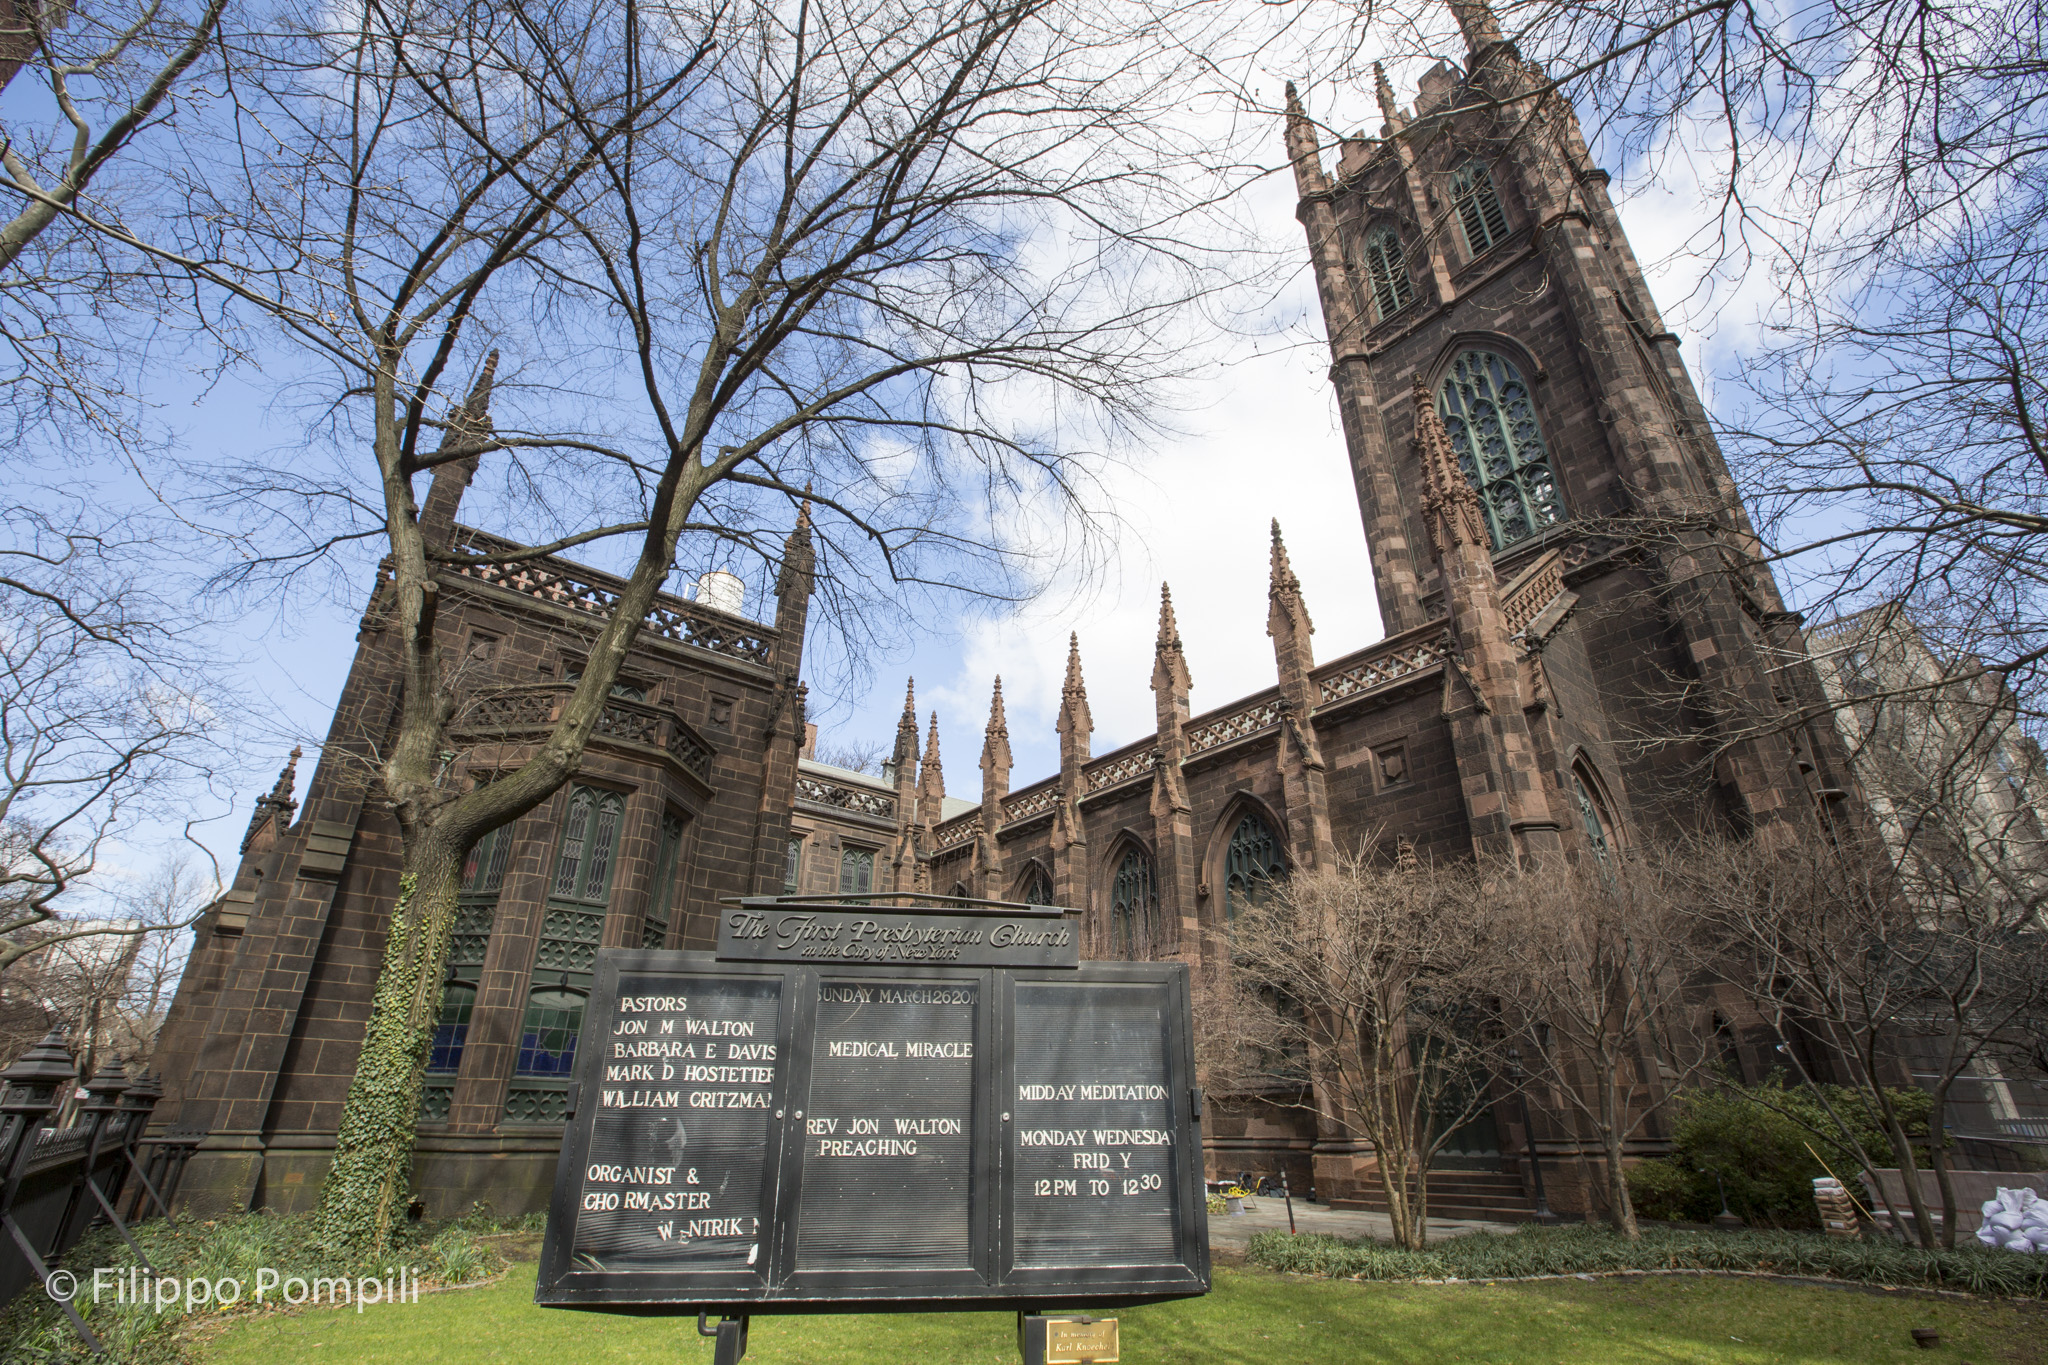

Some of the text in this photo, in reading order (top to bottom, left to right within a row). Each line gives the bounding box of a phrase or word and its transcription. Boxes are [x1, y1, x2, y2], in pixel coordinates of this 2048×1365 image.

[729, 912, 1070, 950] The First Presbyterian Church
[801, 943, 960, 961] in the City of New York
[620, 996, 687, 1013] PASTORS
[613, 1020, 755, 1037] JON M WALTON
[614, 1042, 777, 1061] BARBARA E DAVIS
[828, 1041, 973, 1058] MEDICAL MIRACLE
[606, 1065, 775, 1083] MARK D HOSTETTER
[602, 1090, 680, 1109] WILLIAM
[1019, 1085, 1170, 1101] MIDDAY MEDITATION
[806, 1117, 961, 1135] REV JON WALTON
[1020, 1130, 1088, 1146] MONDAY
[819, 1140, 918, 1157] PREACHING
[587, 1164, 700, 1185] ORGANIST &
[1088, 1179, 1110, 1196] TO
[1055, 1342, 1073, 1353] Karl
